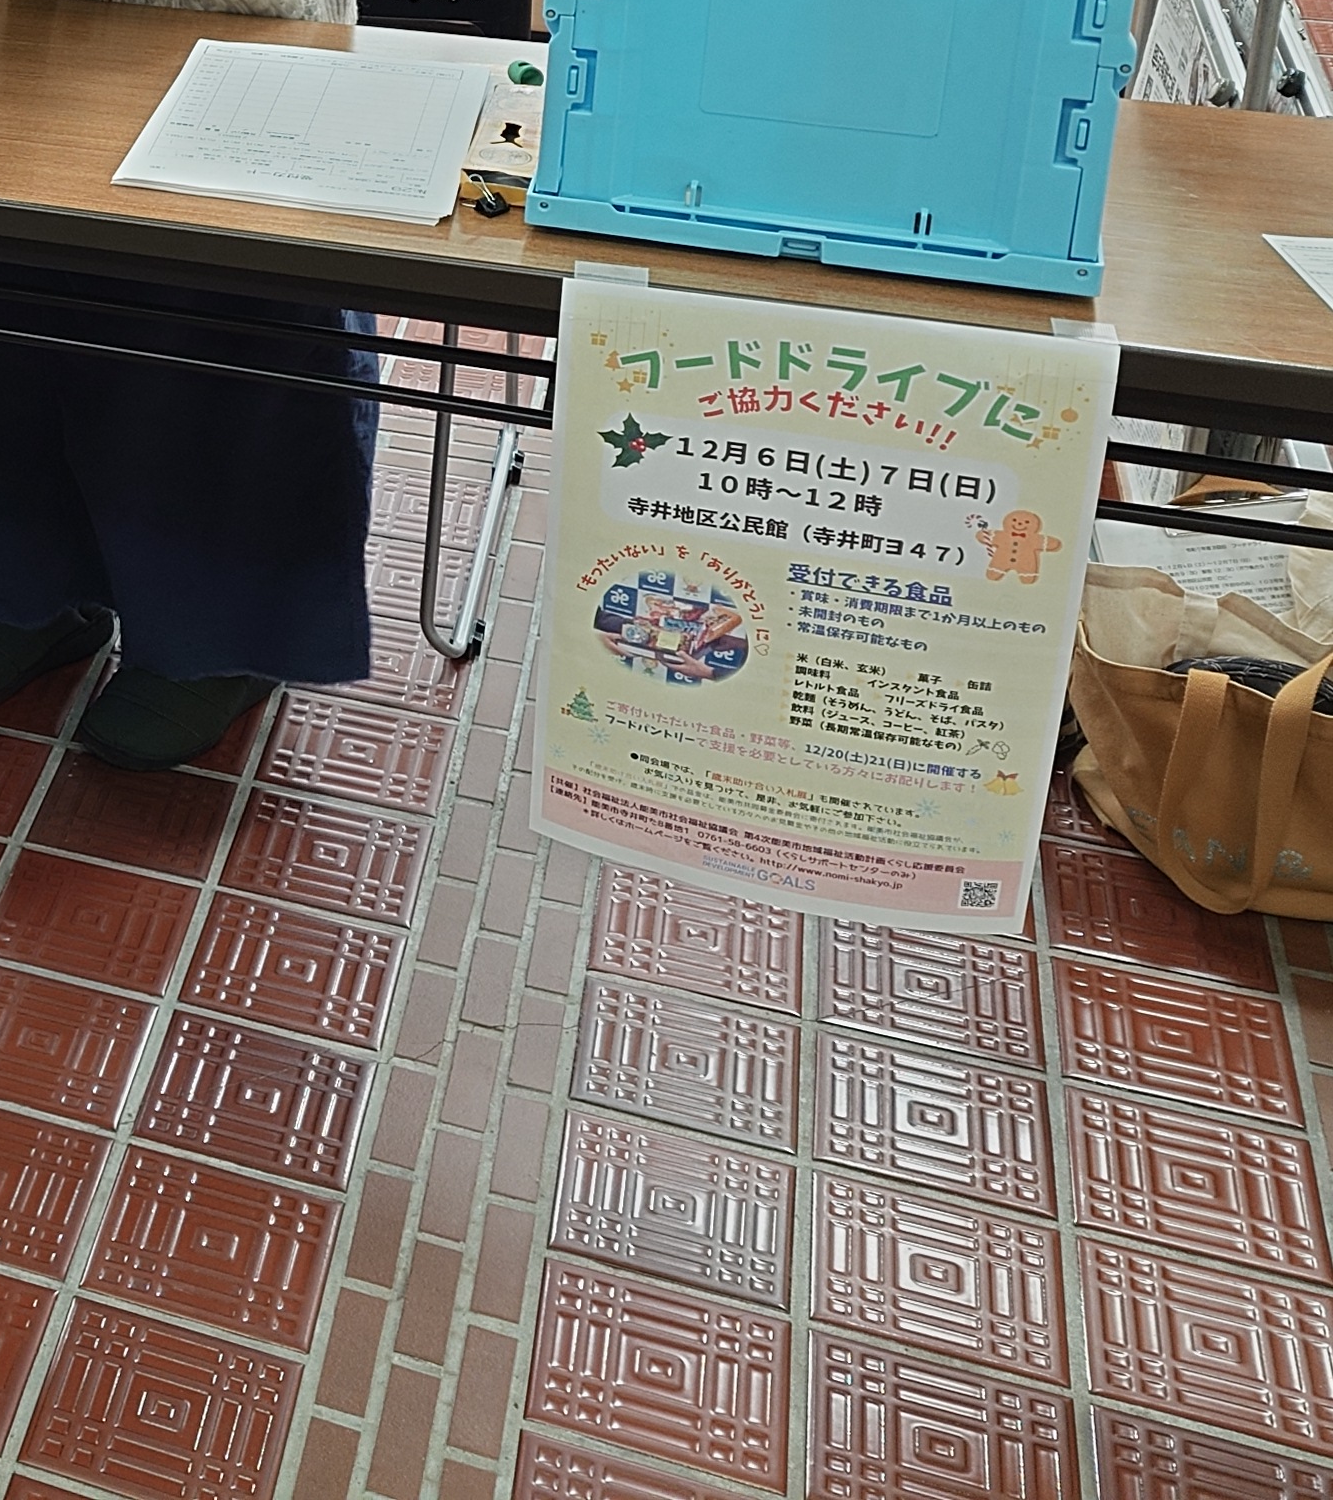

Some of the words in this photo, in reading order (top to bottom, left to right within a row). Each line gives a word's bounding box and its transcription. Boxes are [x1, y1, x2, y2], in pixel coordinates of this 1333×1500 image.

[620, 339, 1040, 442] フードドライブに
[788, 563, 953, 606] 受付できる食品
[795, 665, 831, 680] 調味料
[867, 679, 960, 701] インスタント食品
[796, 653, 887, 677] 米（白米、玄米）
[917, 672, 943, 685] 菓子
[967, 680, 992, 692] 缶詰
[793, 678, 860, 698] レトルト食品
[885, 694, 984, 716] フリーズドライ食品
[702, 861, 755, 879] DEVELOPMENT
[703, 855, 756, 873] SUSTAINABLE
